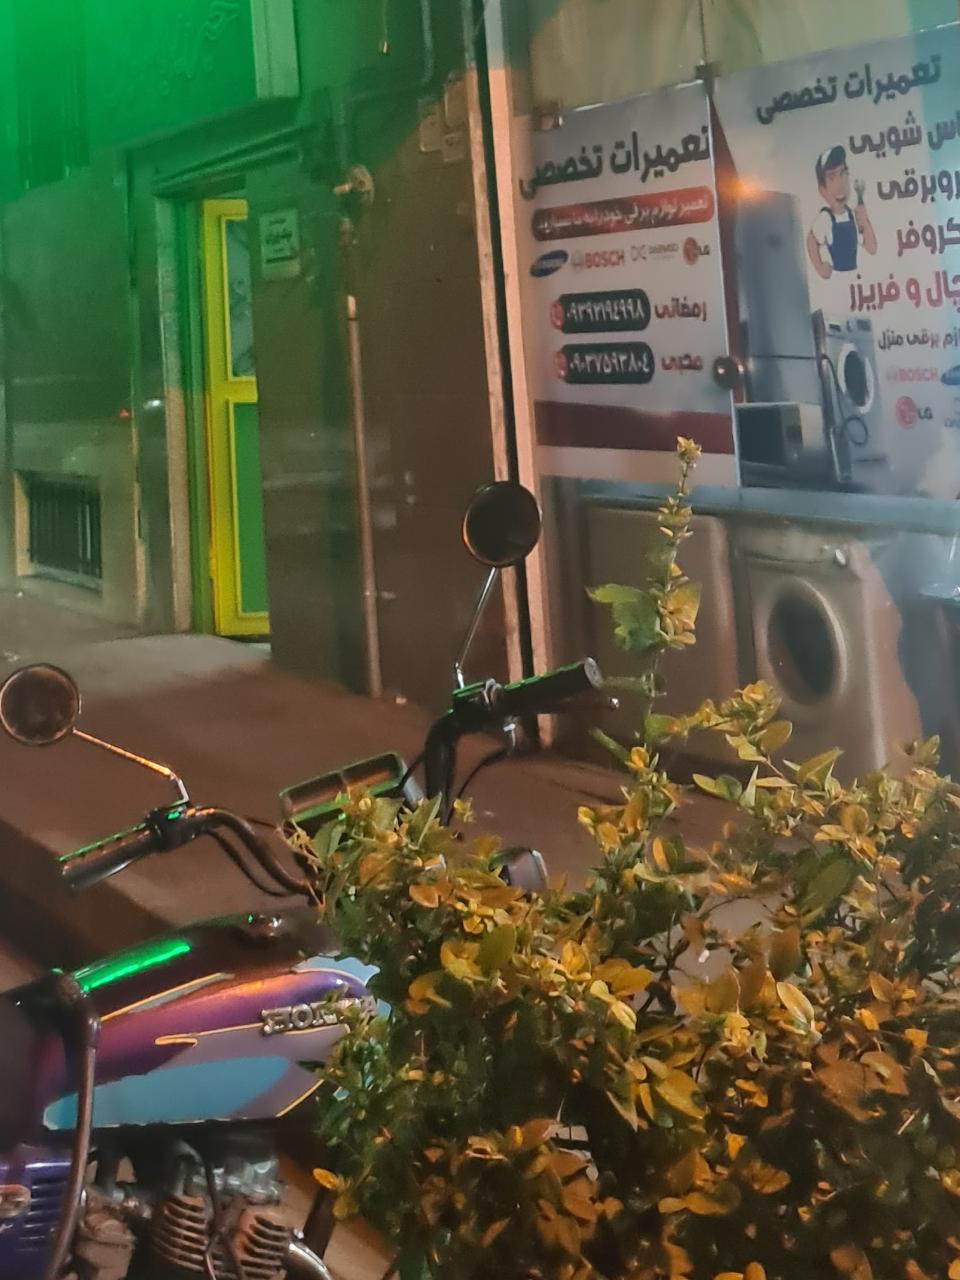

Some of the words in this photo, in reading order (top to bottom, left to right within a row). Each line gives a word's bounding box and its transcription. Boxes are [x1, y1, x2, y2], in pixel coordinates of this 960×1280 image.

[843, 54, 942, 104] تعمیرات
[756, 75, 838, 125] تخصصی
[849, 110, 922, 159] شویی
[927, 109, 960, 151] اس
[519, 145, 603, 199] تخصصی
[610, 126, 710, 182] تعمیرات
[877, 167, 960, 204] روبرقی
[897, 217, 960, 257] کروفر
[584, 249, 625, 269] BOSCH
[849, 274, 901, 312] فریزر
[906, 277, 921, 308] و
[926, 270, 960, 314] چال
[878, 328, 904, 350] منزل
[906, 329, 940, 349] برقی
